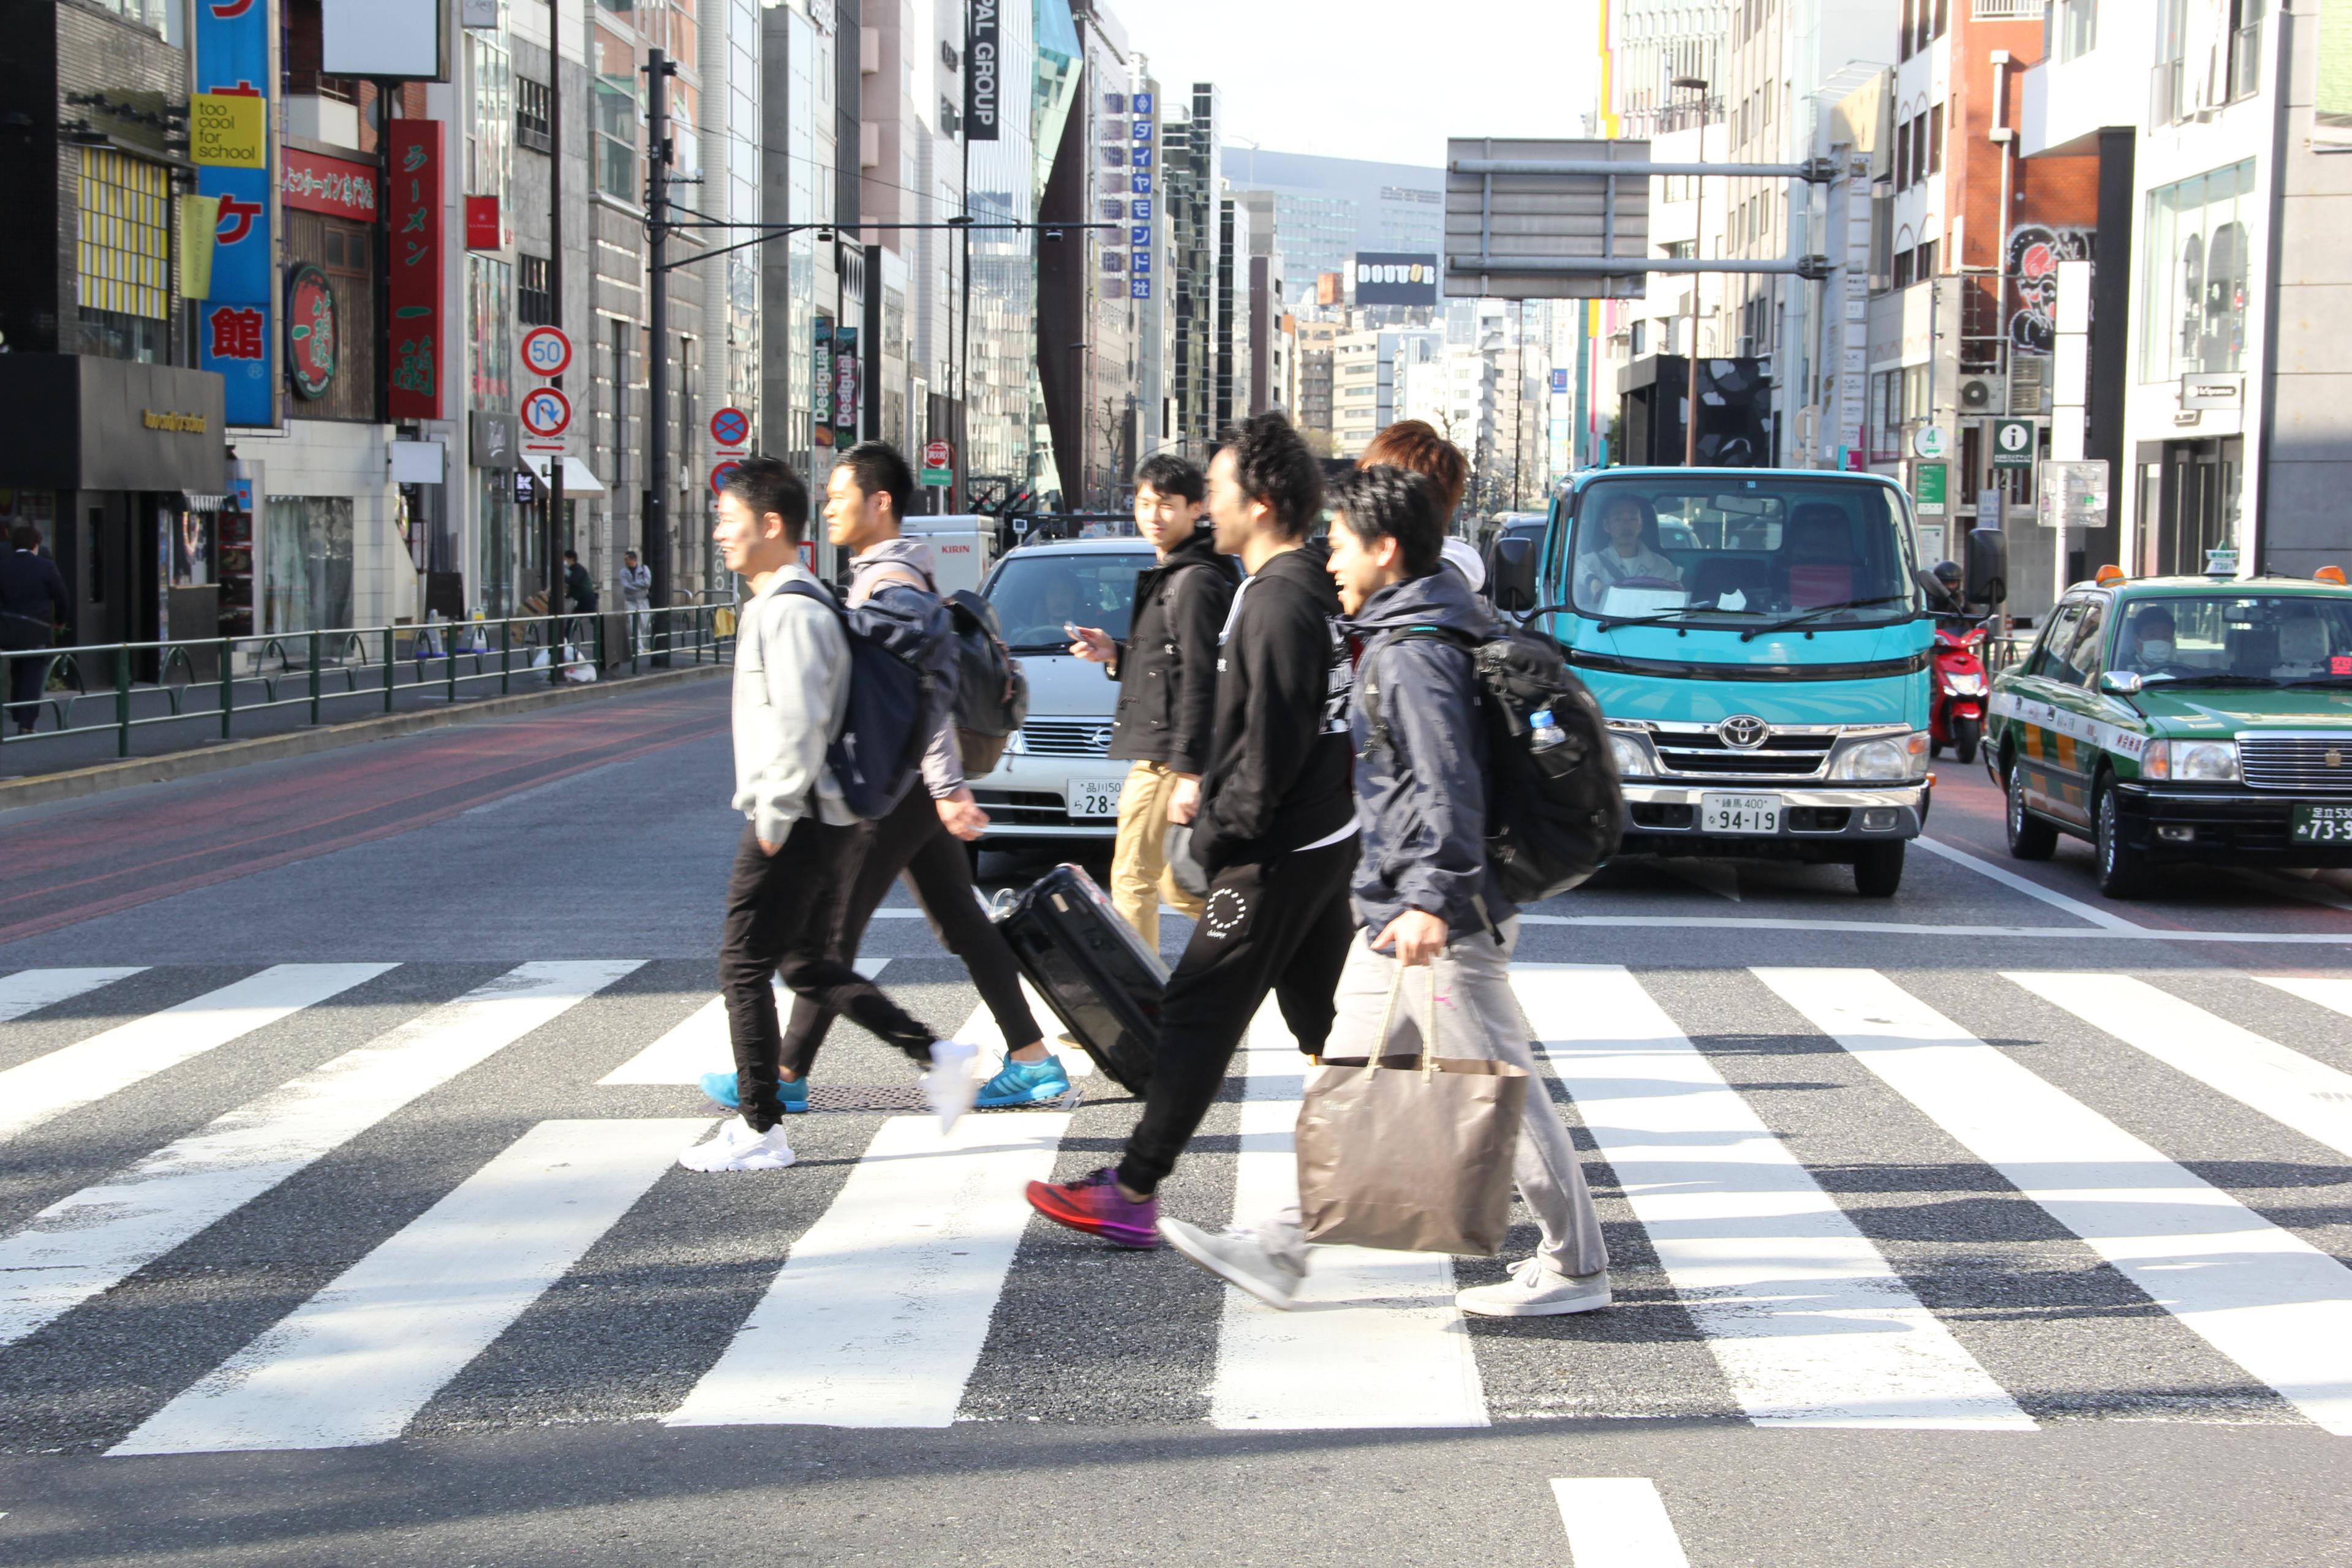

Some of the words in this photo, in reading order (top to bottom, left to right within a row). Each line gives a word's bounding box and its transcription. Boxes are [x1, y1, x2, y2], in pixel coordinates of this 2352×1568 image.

[974, 42, 995, 126] GROUP
[198, 102, 227, 116] too
[198, 115, 235, 129] cool
[198, 129, 222, 143] for
[198, 145, 255, 160] school
[402, 145, 429, 266] ラーメン
[1133, 123, 1152, 295] ダイヤモンド社
[1358, 263, 1434, 284] DOUTOR
[533, 341, 561, 362] 50
[1926, 430, 1936, 444] 4
[1087, 783, 1107, 793] 品川
[1074, 800, 1082, 809] ら
[1722, 798, 1743, 808] 練馬
[1744, 799, 1763, 809] 400
[2312, 807, 2334, 818] 足立
[1708, 815, 1716, 824] な
[1720, 810, 1774, 830] 94-19
[2297, 824, 2308, 834] あ
